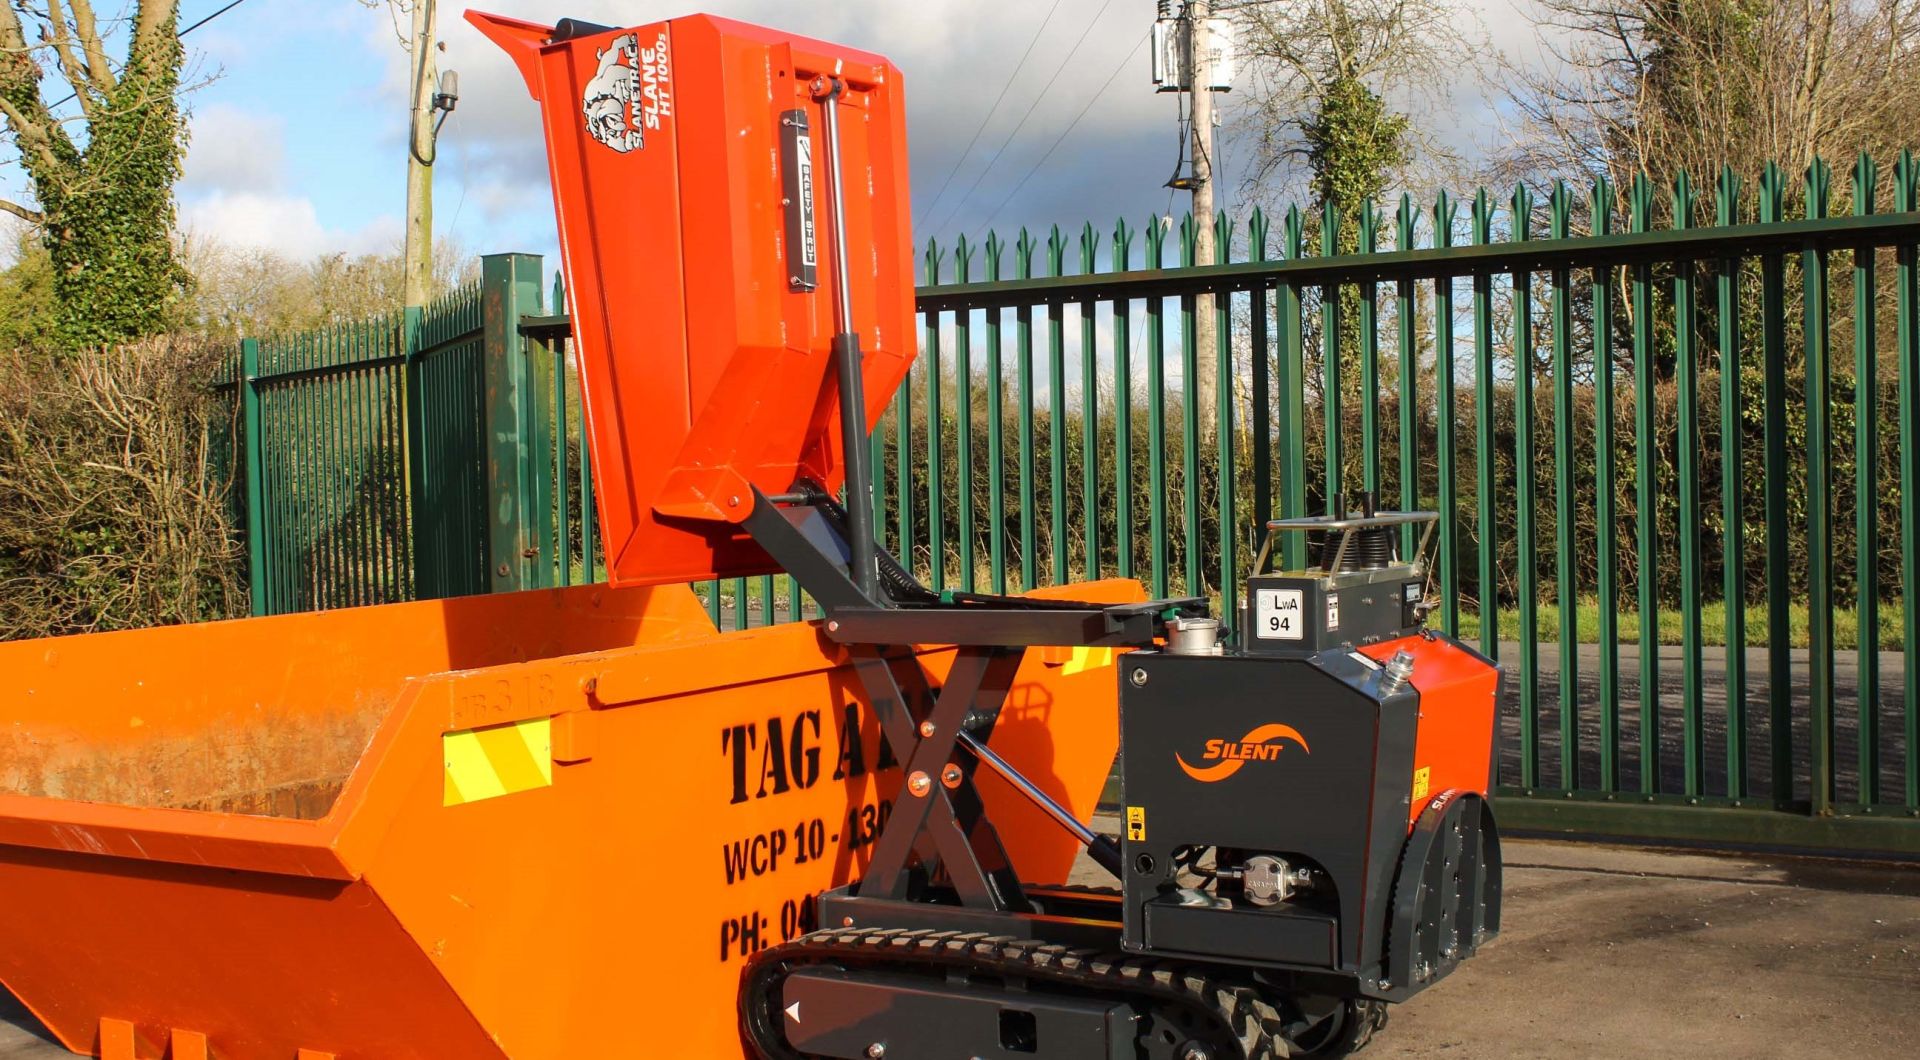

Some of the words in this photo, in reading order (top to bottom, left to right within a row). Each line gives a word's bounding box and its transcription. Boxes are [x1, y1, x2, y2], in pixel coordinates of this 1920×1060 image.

[641, 47, 660, 130] SLANE
[659, 88, 671, 116] HT
[802, 165, 812, 214] SAFETY
[805, 220, 814, 261] STRUT
[1270, 616, 1290, 631] 94
[721, 709, 821, 804] TAG
[1203, 739, 1284, 760] SILENT
[723, 828, 787, 885] WCP
[794, 818, 825, 865] 10
[720, 911, 768, 962] PH:
